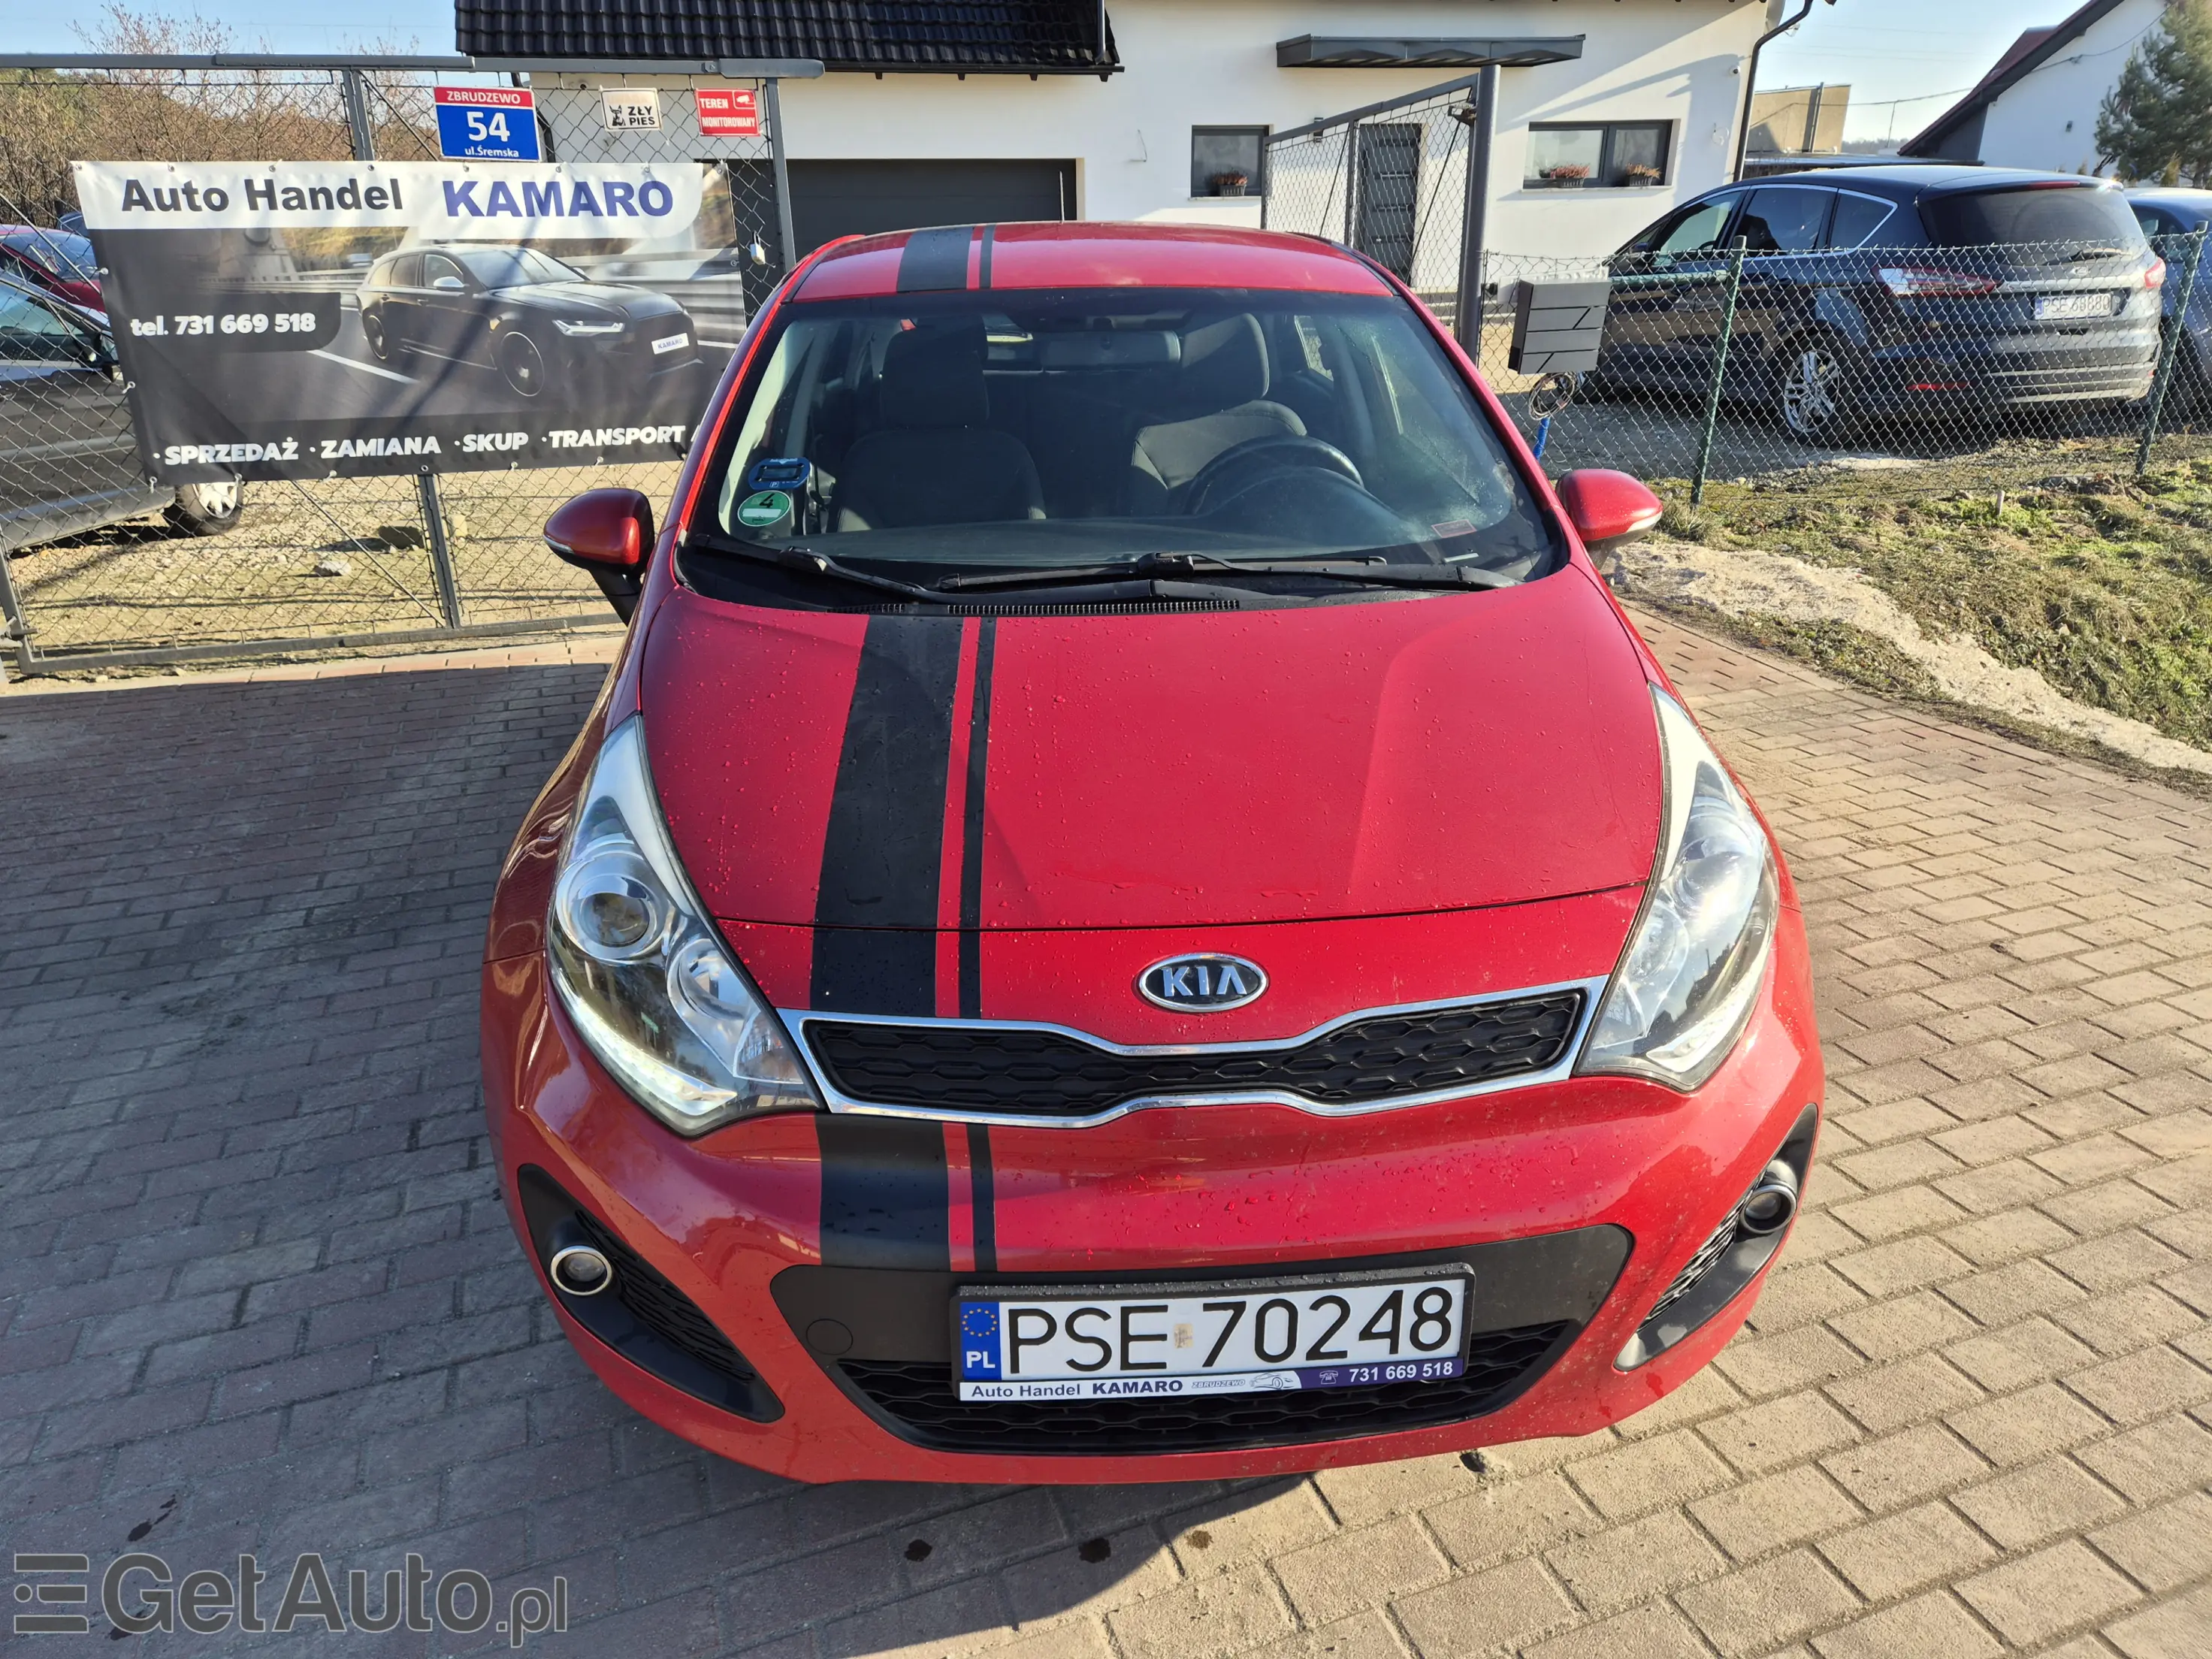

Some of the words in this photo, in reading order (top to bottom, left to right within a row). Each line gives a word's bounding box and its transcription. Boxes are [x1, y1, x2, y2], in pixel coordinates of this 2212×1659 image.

[446, 90, 521, 104] ZBRUDZEWO
[700, 98, 729, 109] TEREN
[627, 106, 652, 116] ZŁY
[467, 111, 510, 142] 54
[629, 116, 655, 125] PIES
[701, 116, 755, 128] MONITOROWANY
[122, 179, 229, 212] Auto
[244, 178, 403, 211] Handel
[442, 180, 673, 216] KAMARO
[131, 315, 169, 337] tel.
[174, 315, 214, 336] 731
[220, 313, 269, 334] 669
[274, 313, 316, 333] 518
[657, 338, 683, 349] KAMARO
[165, 437, 299, 465] SPRZEDAŻ
[320, 436, 442, 459] ZAMIANA
[462, 431, 529, 452] SKUP
[548, 425, 686, 448] TRANSPORT
[759, 493, 775, 508] 4
[1161, 965, 1247, 998] KIA
[1008, 1304, 1168, 1374] PSE
[1202, 1286, 1452, 1368] 70248
[966, 1351, 996, 1369] PL
[971, 1385, 1013, 1398] Auto
[1020, 1383, 1080, 1397] Handel
[1092, 1379, 1183, 1395] KAMARO
[1191, 1379, 1246, 1389] ZBRUDZEWO
[1349, 1367, 1379, 1382] 731
[1385, 1364, 1417, 1379] 669
[1422, 1361, 1453, 1378] 518
